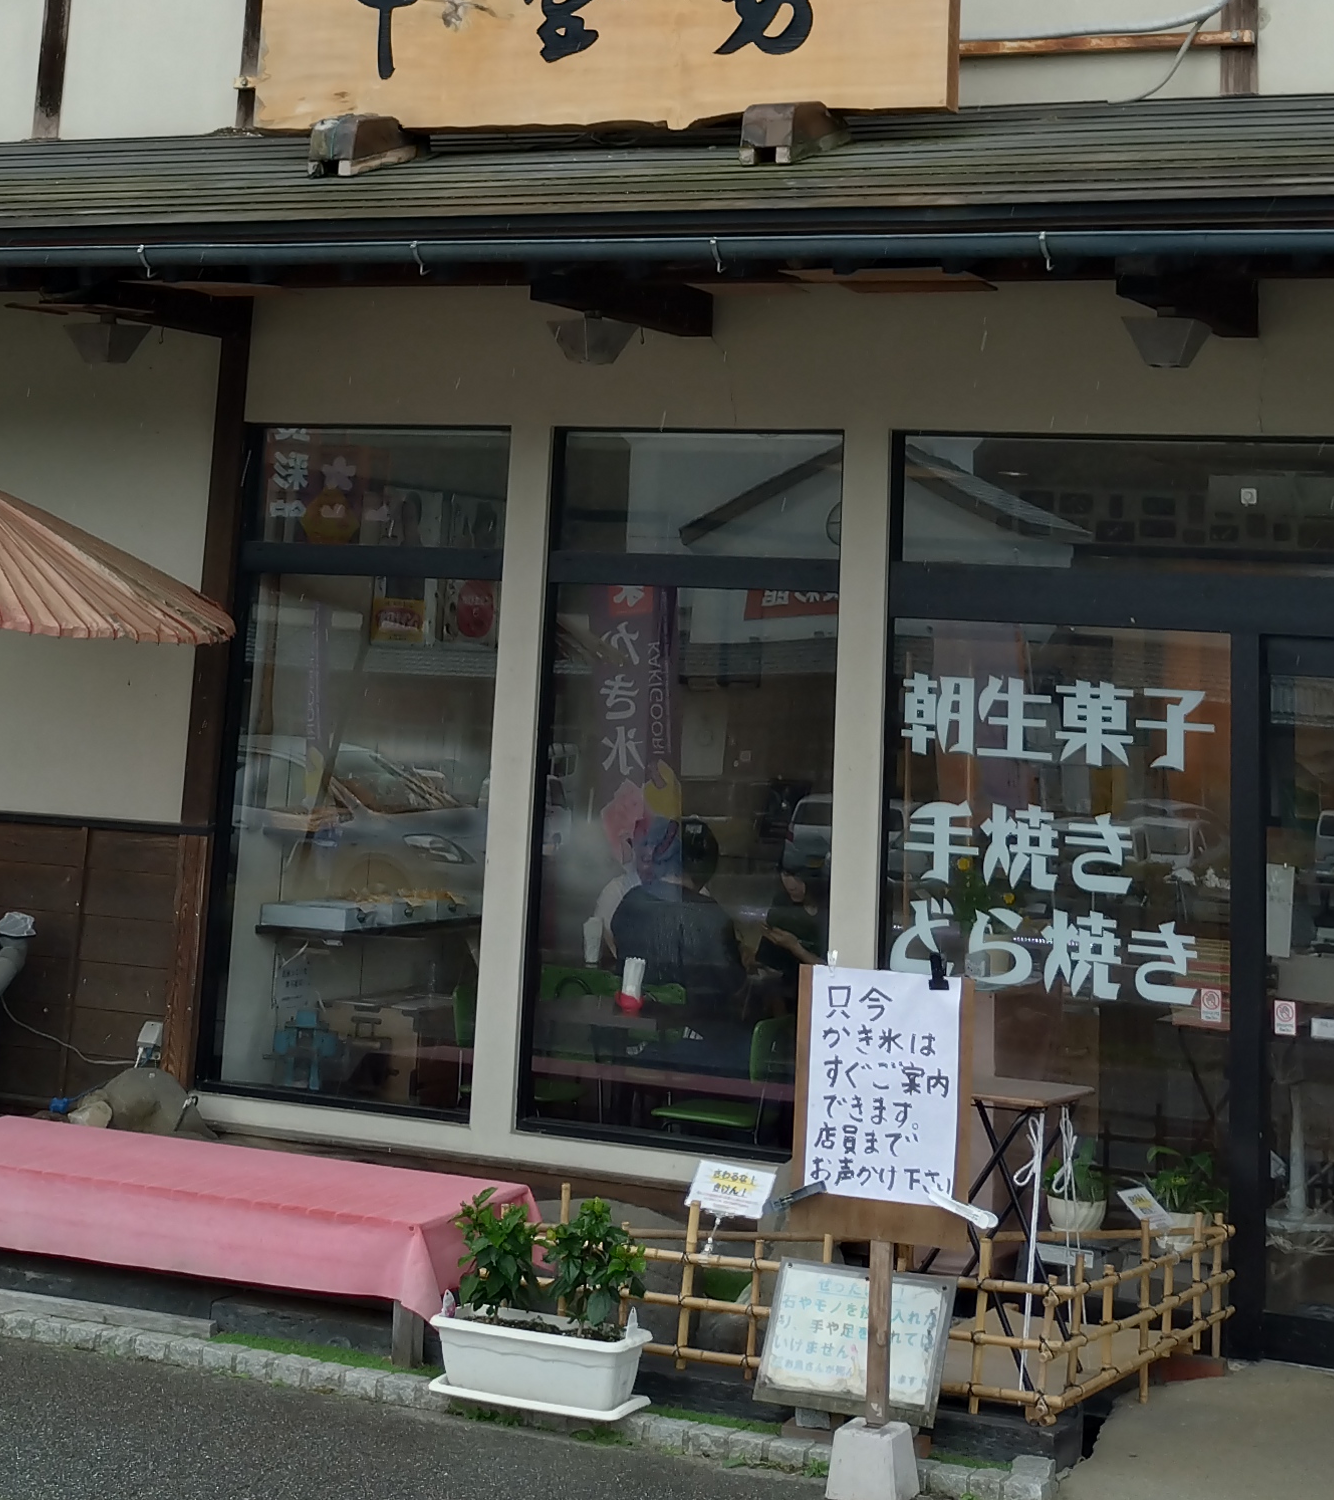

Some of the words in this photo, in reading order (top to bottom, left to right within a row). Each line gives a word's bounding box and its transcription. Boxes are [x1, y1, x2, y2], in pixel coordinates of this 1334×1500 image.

[900, 672, 1216, 772] 朝生菓子
[903, 800, 1134, 895] 手焼き
[889, 897, 1198, 1005] どら焼き
[826, 985, 893, 1022] 只今
[822, 1024, 936, 1056] かき氷は
[823, 1054, 949, 1098] すぐご案内
[823, 1095, 919, 1130] できます。
[814, 1121, 919, 1157] 店員まで
